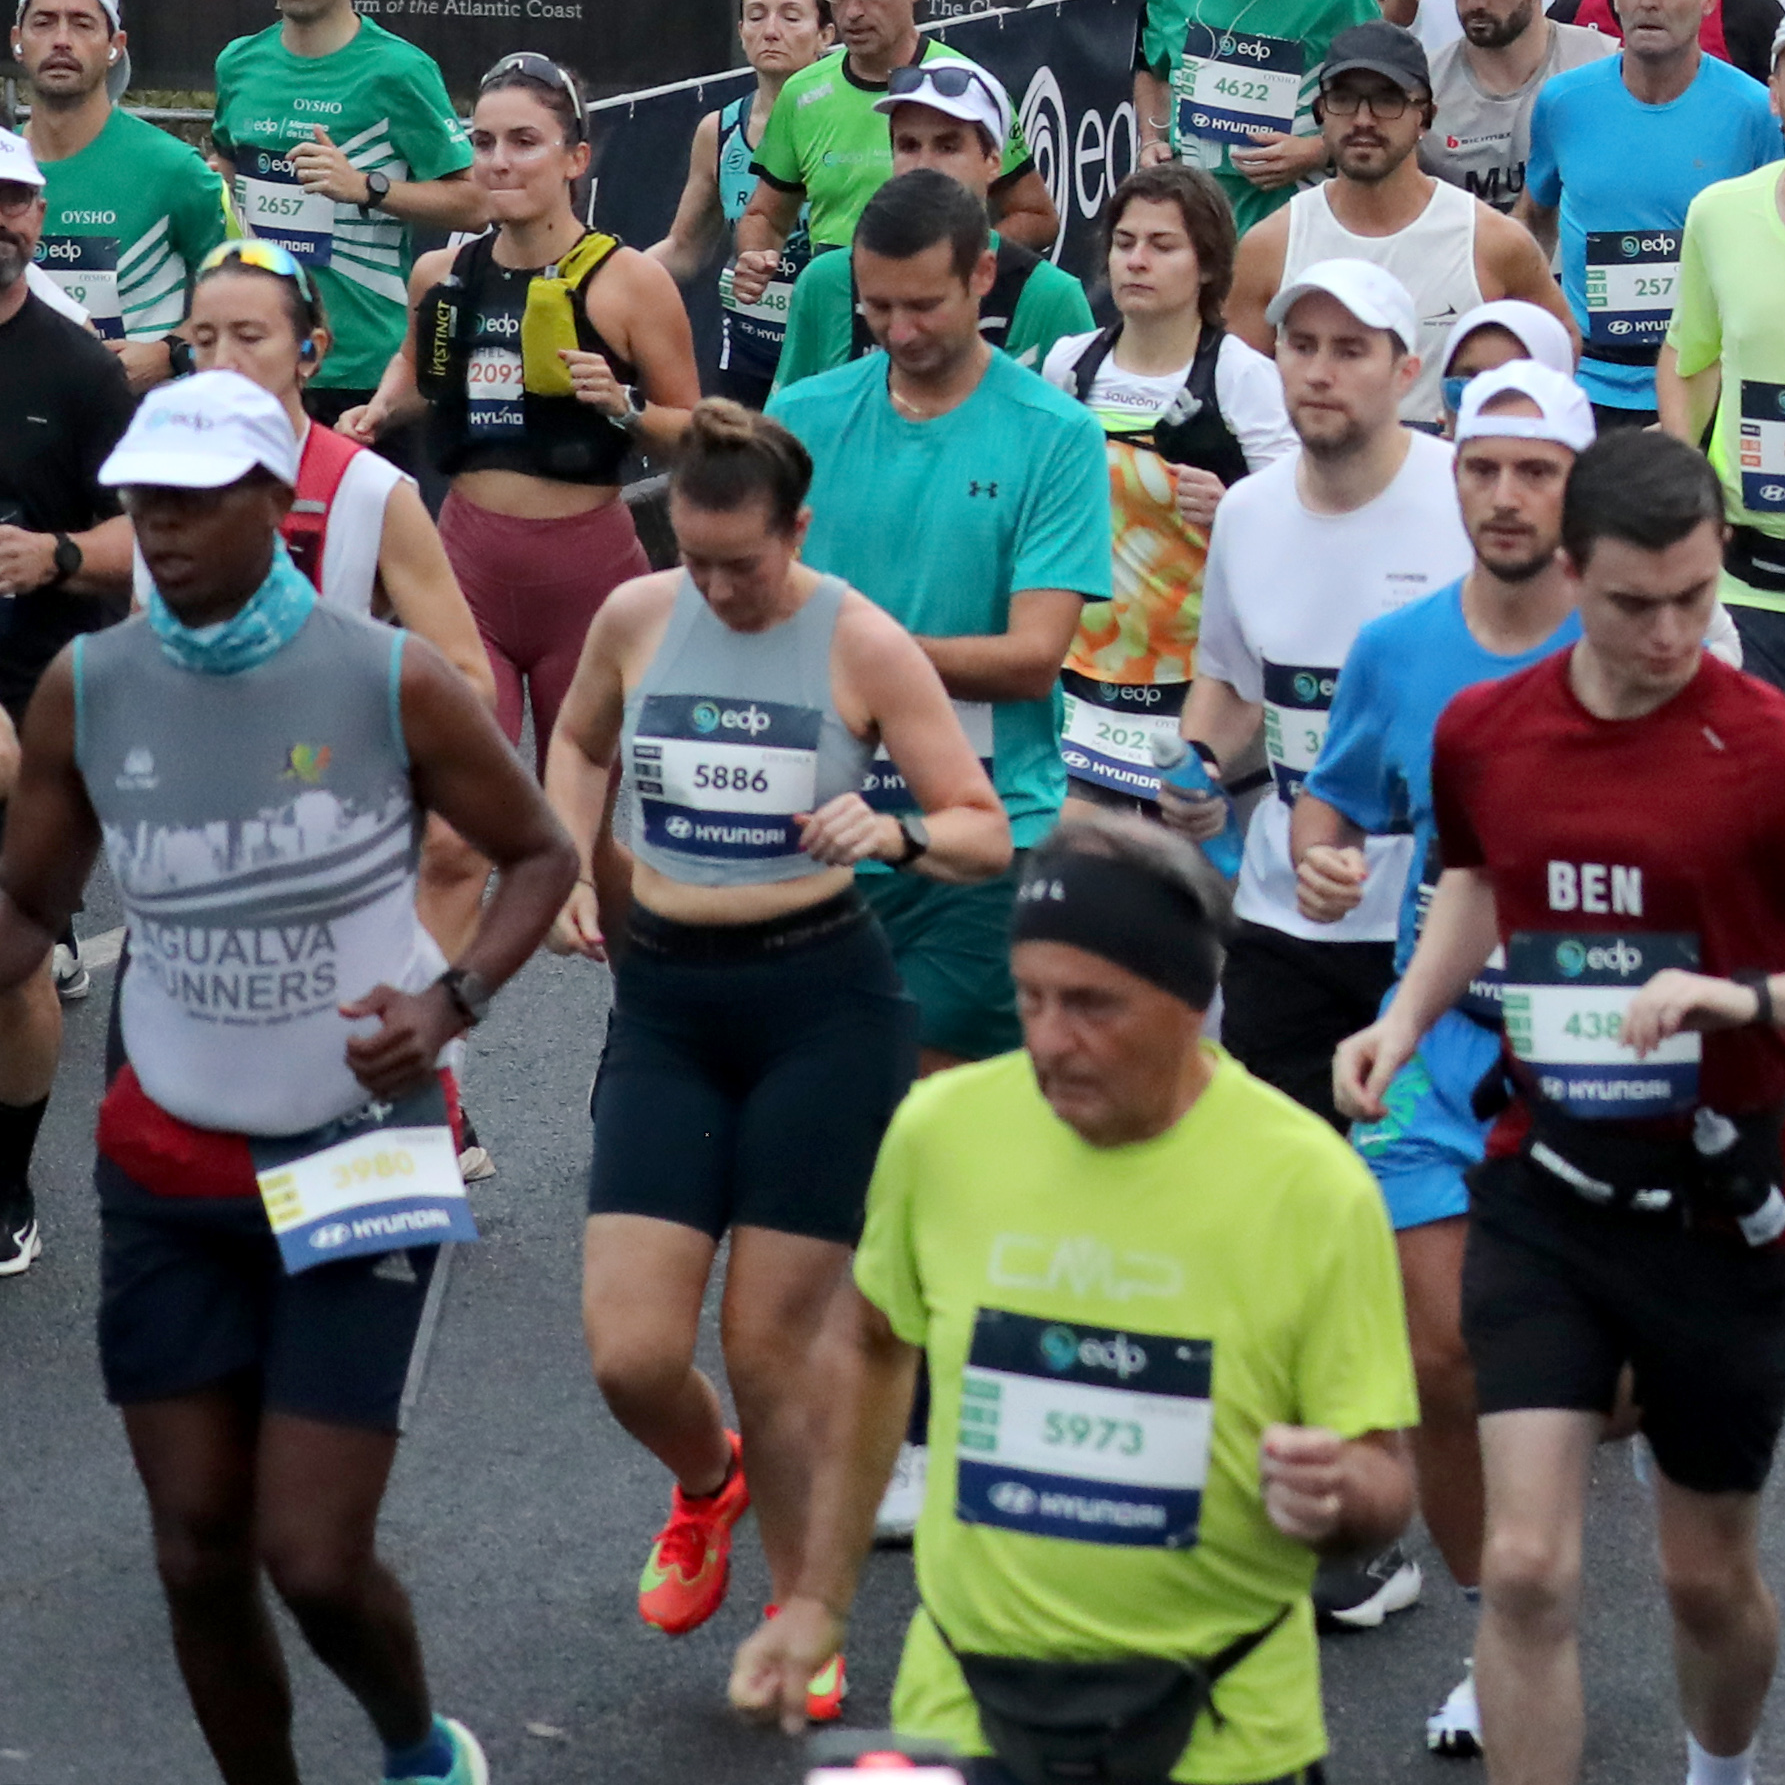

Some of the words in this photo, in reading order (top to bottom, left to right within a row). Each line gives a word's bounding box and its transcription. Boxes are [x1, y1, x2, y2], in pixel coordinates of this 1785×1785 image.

[526, 0, 582, 19] Coast
[1237, 41, 1271, 61] edp
[1214, 77, 1269, 102] 4622
[294, 98, 342, 115] OYSHO
[253, 117, 278, 134] edp
[61, 211, 116, 225] OYSHO
[257, 195, 304, 218] 2657
[49, 240, 81, 262] edp
[1642, 234, 1676, 255] edp
[777, 257, 797, 277] dp
[486, 312, 520, 338] edp
[1104, 389, 1163, 412] saucony
[1120, 686, 1161, 707] edp
[721, 705, 771, 737] edp
[694, 764, 769, 794] 5886
[1092, 762, 1161, 791] HYUNDA
[694, 824, 786, 846] HYUNDAI
[1547, 859, 1643, 916] BEN
[1586, 938, 1643, 978] edp
[158, 962, 338, 1013] UNNERS
[1569, 1079, 1671, 1101] HYUNDAI
[352, 1208, 450, 1238] HYUNDAI
[1077, 1333, 1149, 1379] edp
[1042, 1411, 1146, 1457] 5973
[1039, 1491, 1167, 1528] HYUNDAI
